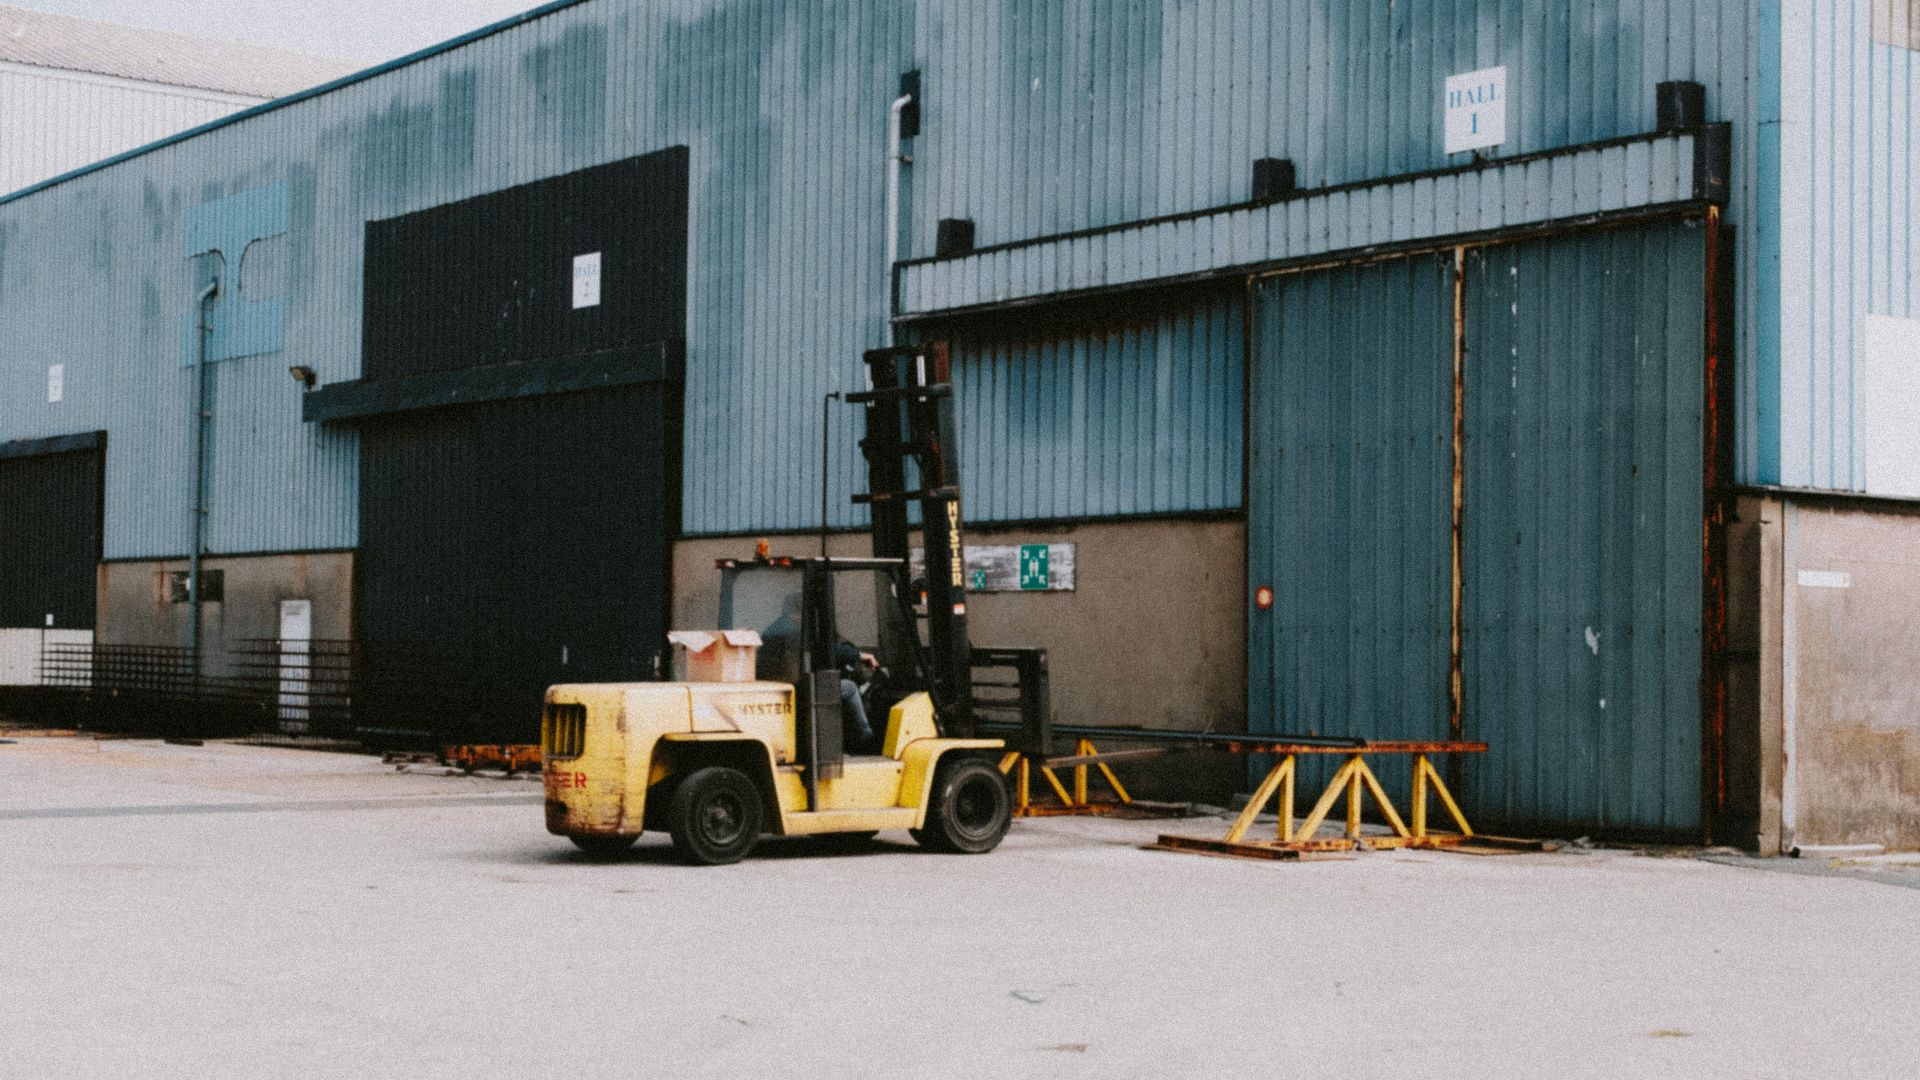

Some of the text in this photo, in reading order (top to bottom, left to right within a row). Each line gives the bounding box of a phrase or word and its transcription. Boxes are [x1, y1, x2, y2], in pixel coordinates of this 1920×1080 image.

[1449, 82, 1501, 109] HALL
[1470, 111, 1479, 134] 1
[947, 501, 962, 587] HYSTER
[738, 703, 792, 716] HYSTER
